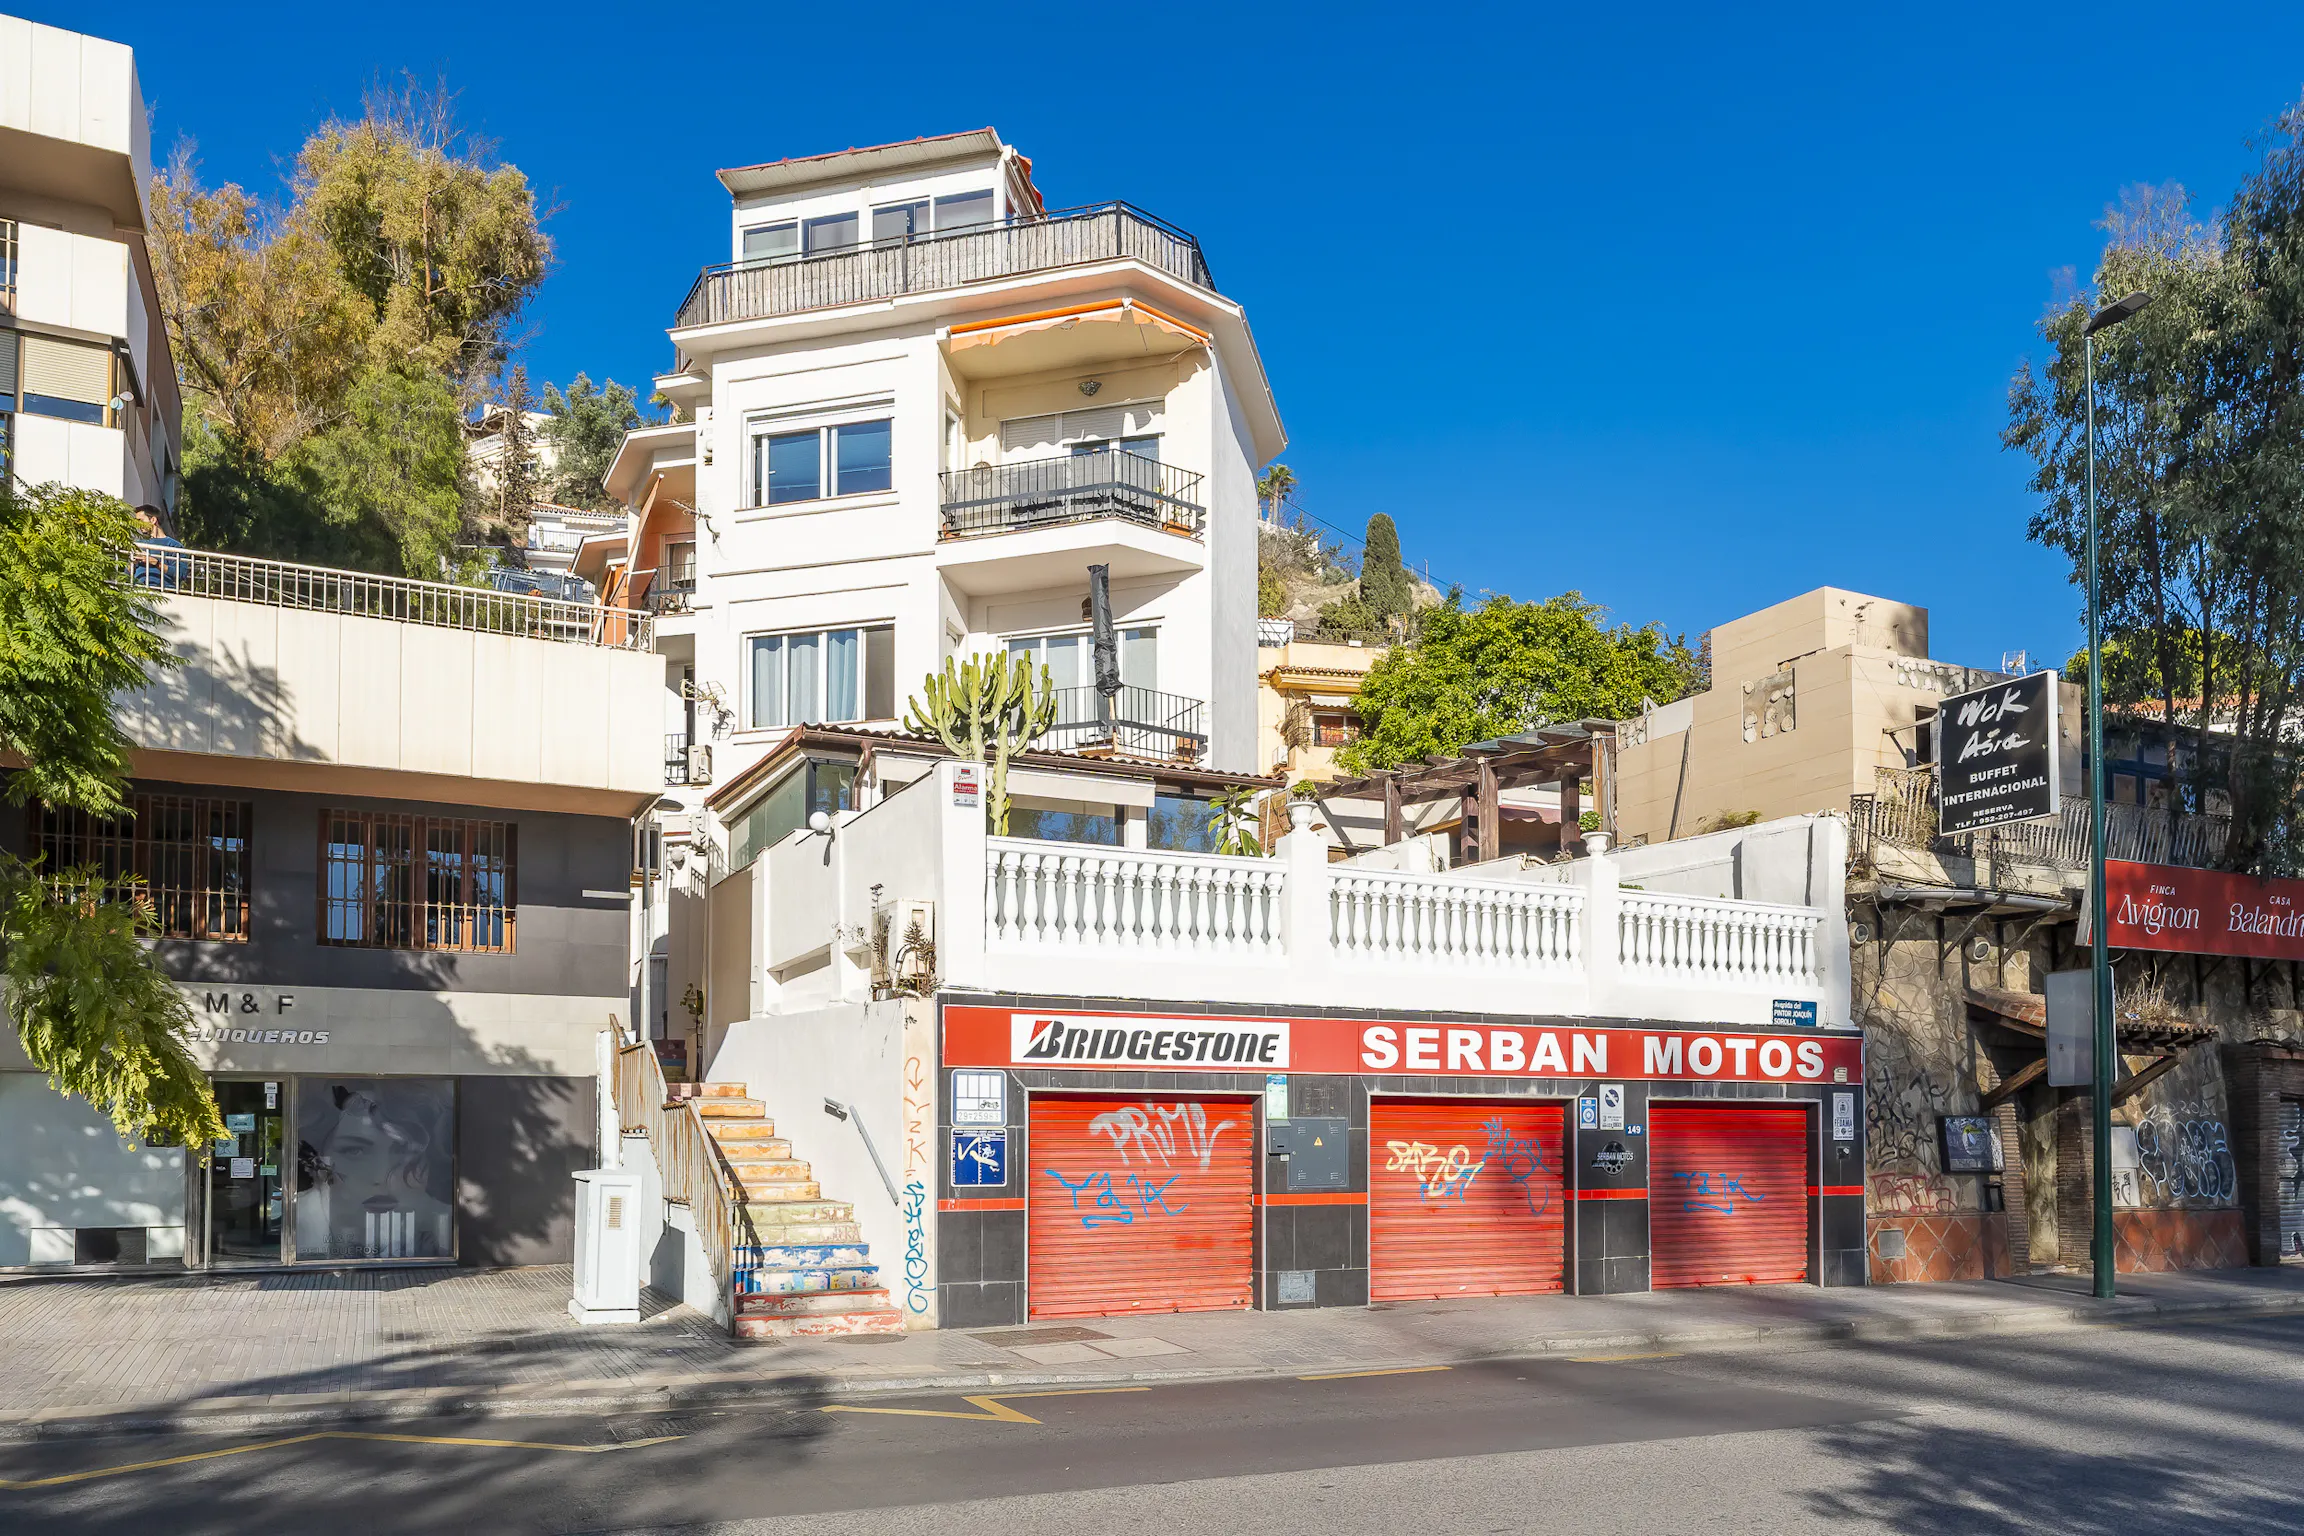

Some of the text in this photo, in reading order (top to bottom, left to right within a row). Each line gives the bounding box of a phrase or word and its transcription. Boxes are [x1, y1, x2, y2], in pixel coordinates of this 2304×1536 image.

[1969, 763, 2018, 784] BUFFET
[1943, 775, 2047, 807] INTERNACIONAL
[1972, 803, 2014, 818] RESERVA
[1979, 807, 2034, 825] 952-207-497
[2150, 884, 2176, 896] FINCA
[2269, 895, 2291, 906] CASA
[2116, 893, 2200, 935] Avignon
[2227, 902, 2304, 938] Balandr
[206, 992, 294, 1015] M & F
[1023, 1020, 1280, 1063] BRIDGESTONE
[1361, 1026, 1825, 1078] SERBAN MOTOS
[1627, 1125, 1641, 1135] 149
